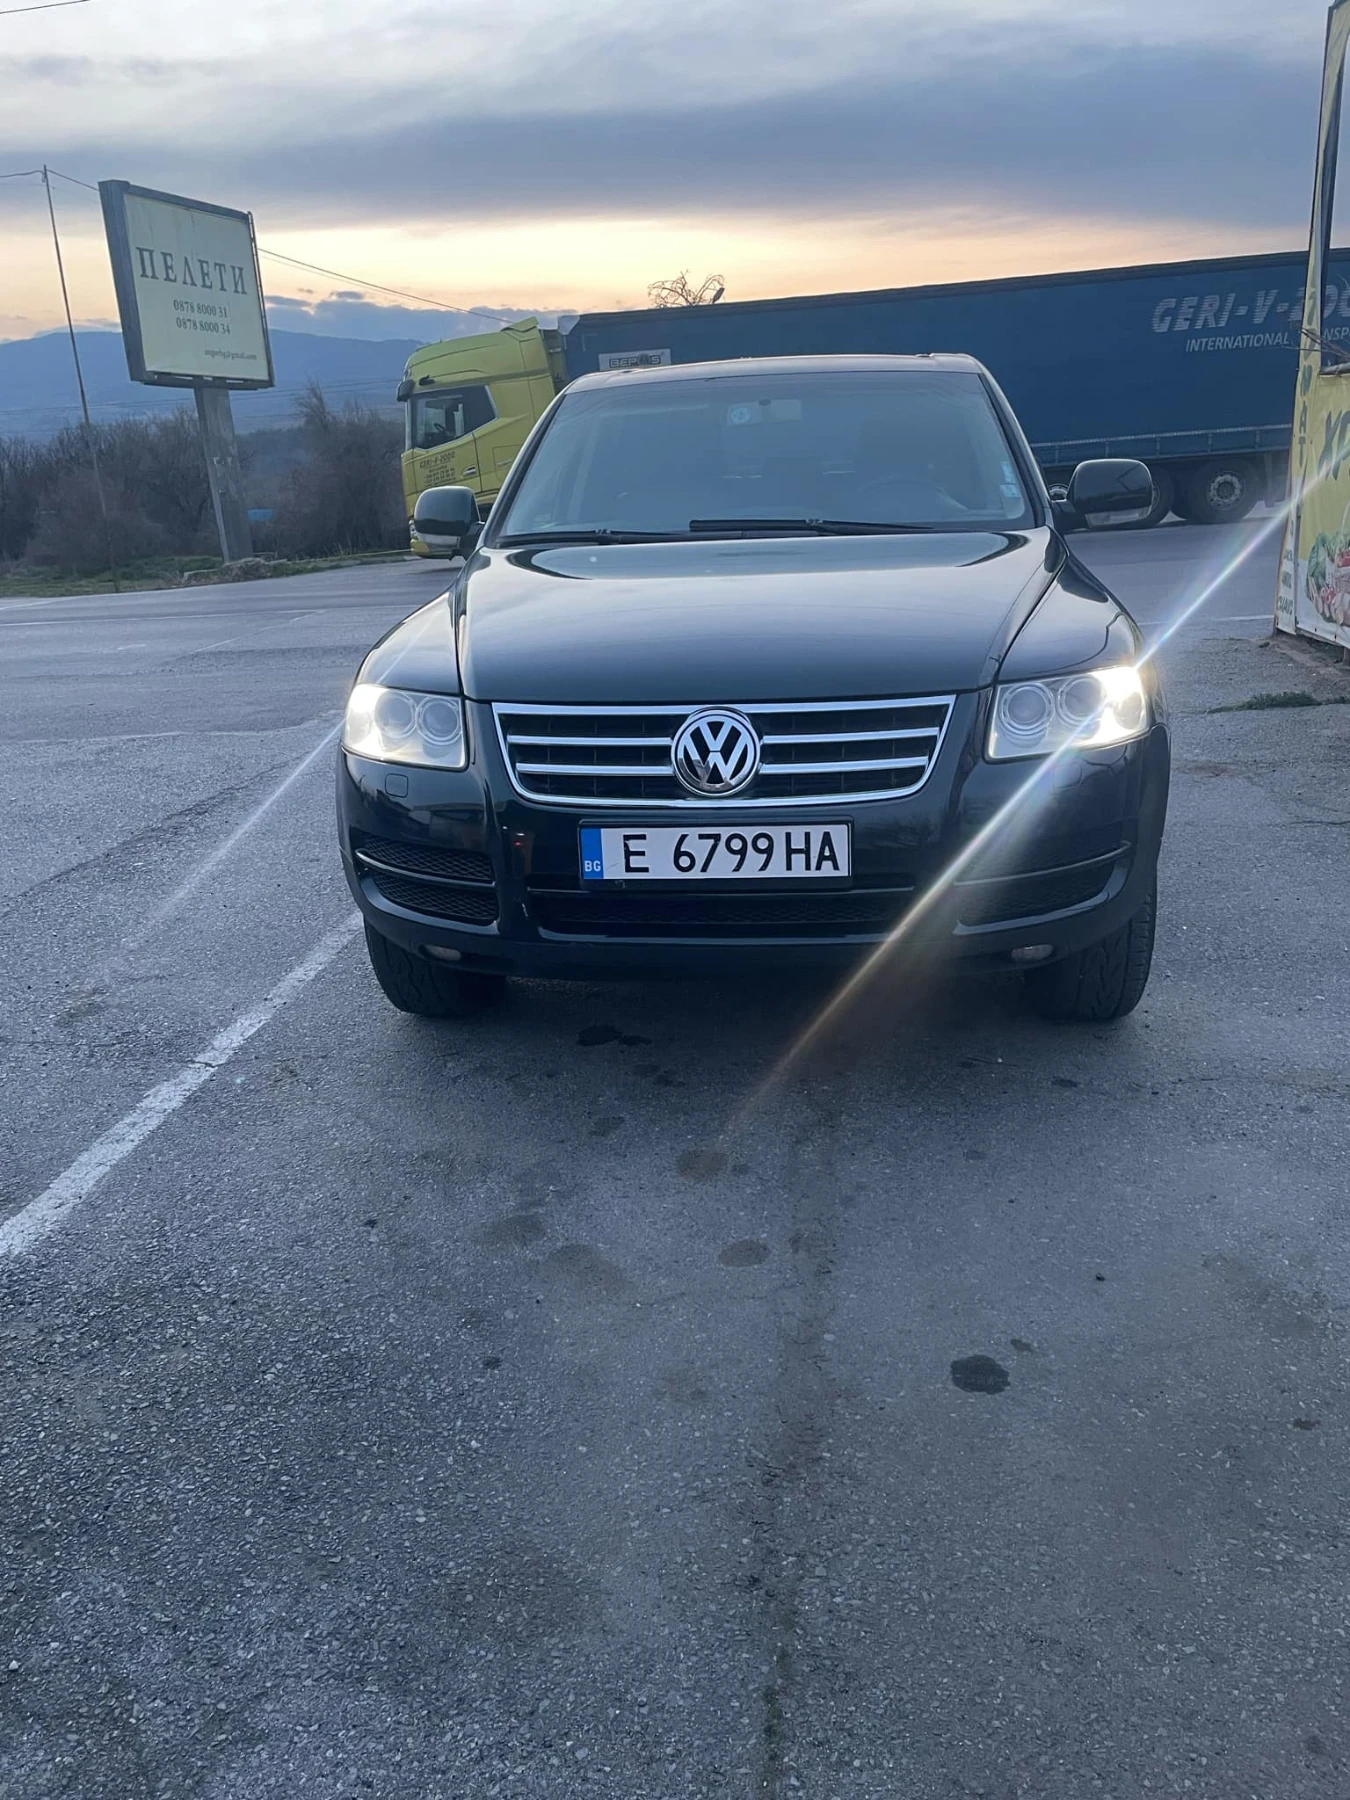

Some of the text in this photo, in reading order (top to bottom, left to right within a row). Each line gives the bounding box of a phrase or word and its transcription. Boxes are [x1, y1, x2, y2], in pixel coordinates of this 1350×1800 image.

[136, 246, 247, 295] ПЕЛЕТИ
[173, 299, 228, 318] 0878 8000 31
[176, 316, 198, 331] 0878
[199, 320, 219, 334] 8000
[1186, 332, 1290, 352] INTERNATIONAL
[622, 831, 840, 873] E 6799 HA
[584, 860, 601, 872] BG
